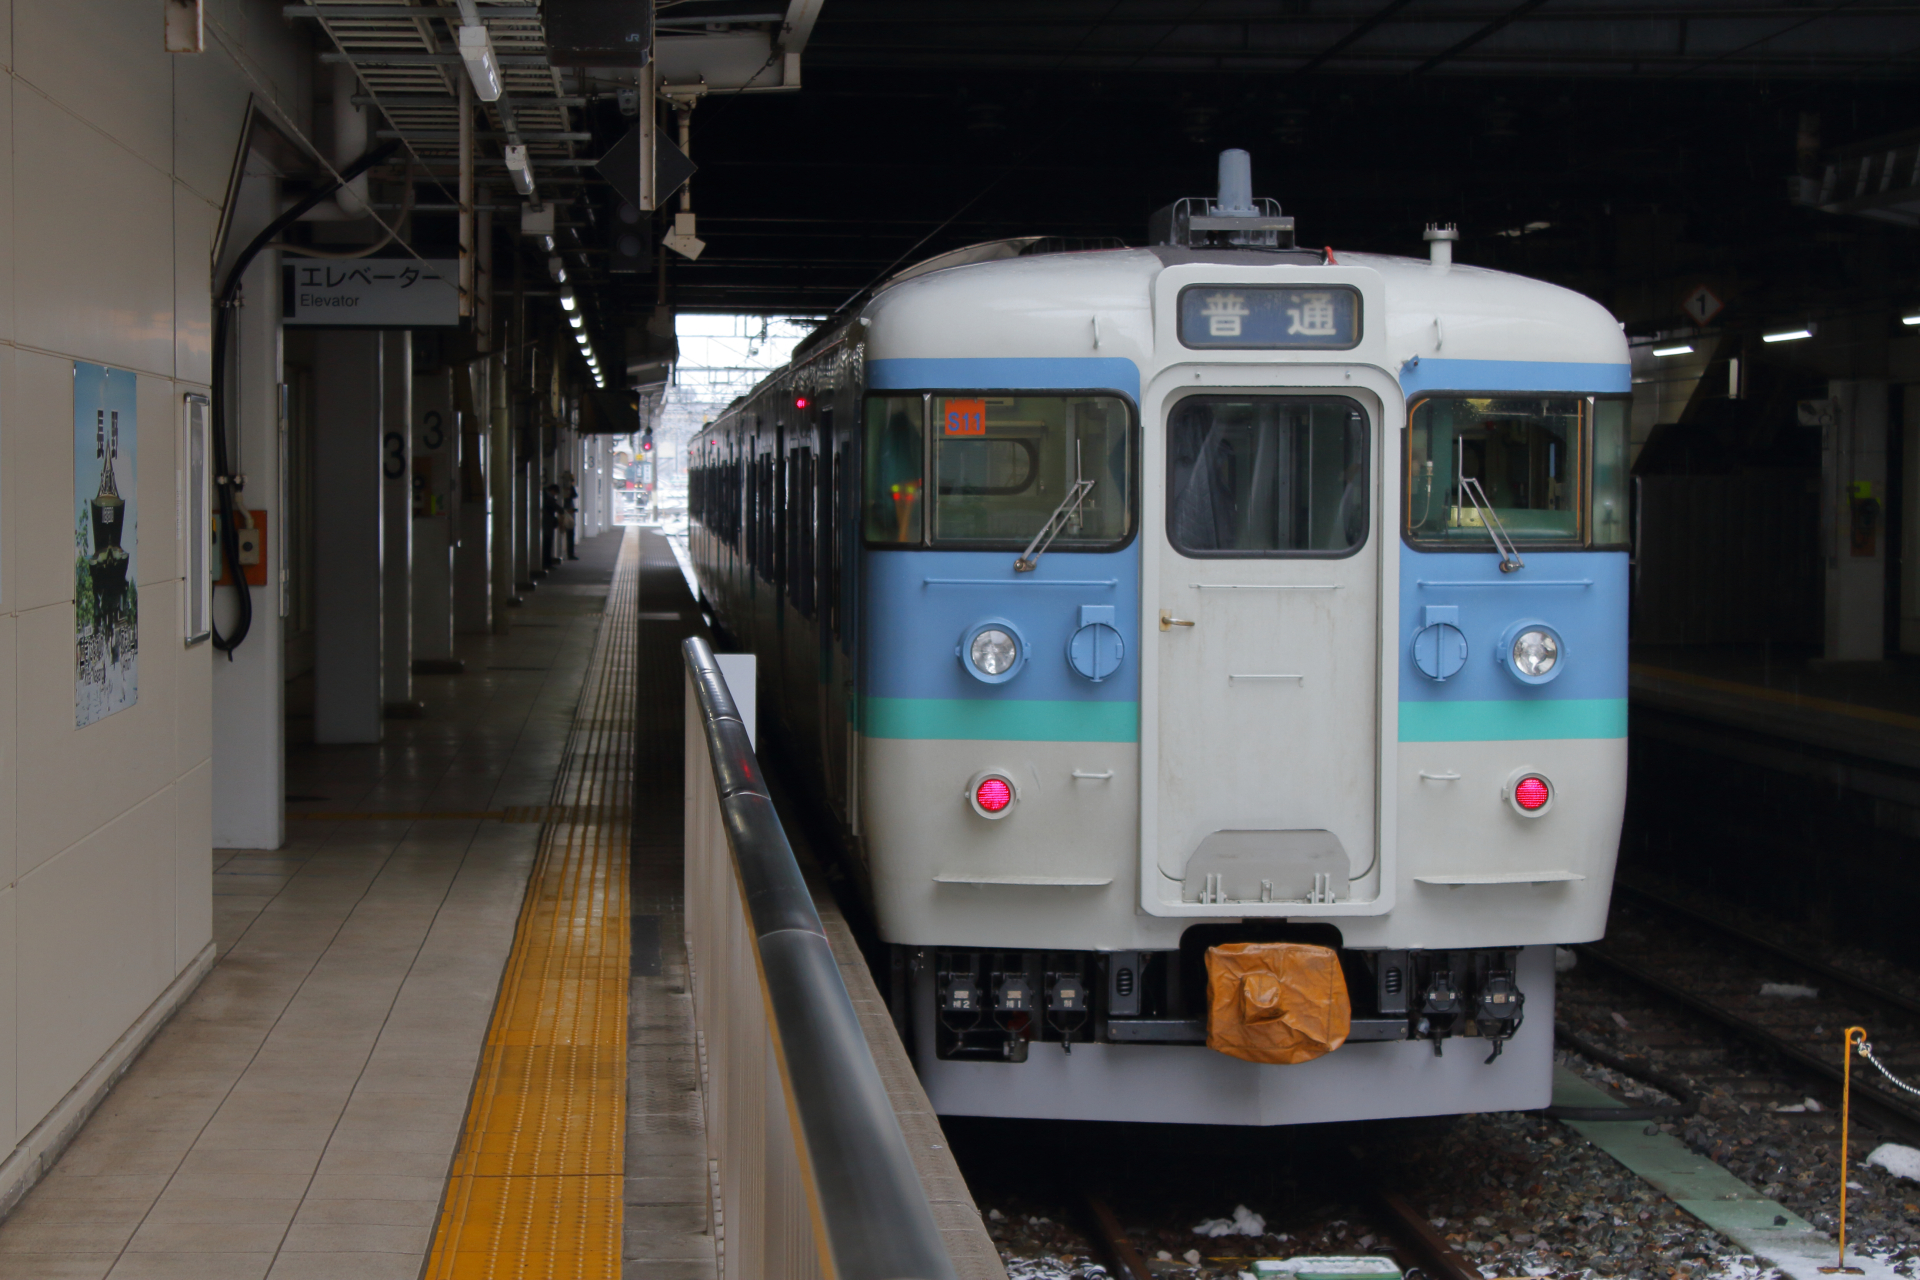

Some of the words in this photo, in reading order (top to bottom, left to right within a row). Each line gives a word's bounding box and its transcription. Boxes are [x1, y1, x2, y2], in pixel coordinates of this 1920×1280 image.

[625, 33, 640, 42] JR
[301, 266, 442, 289] エレベーター
[300, 293, 360, 307] Elevator
[1695, 294, 1706, 317] 1
[1201, 292, 1337, 337] 普通
[423, 410, 443, 450] 3
[947, 411, 981, 432] S11
[384, 431, 406, 480] 3
